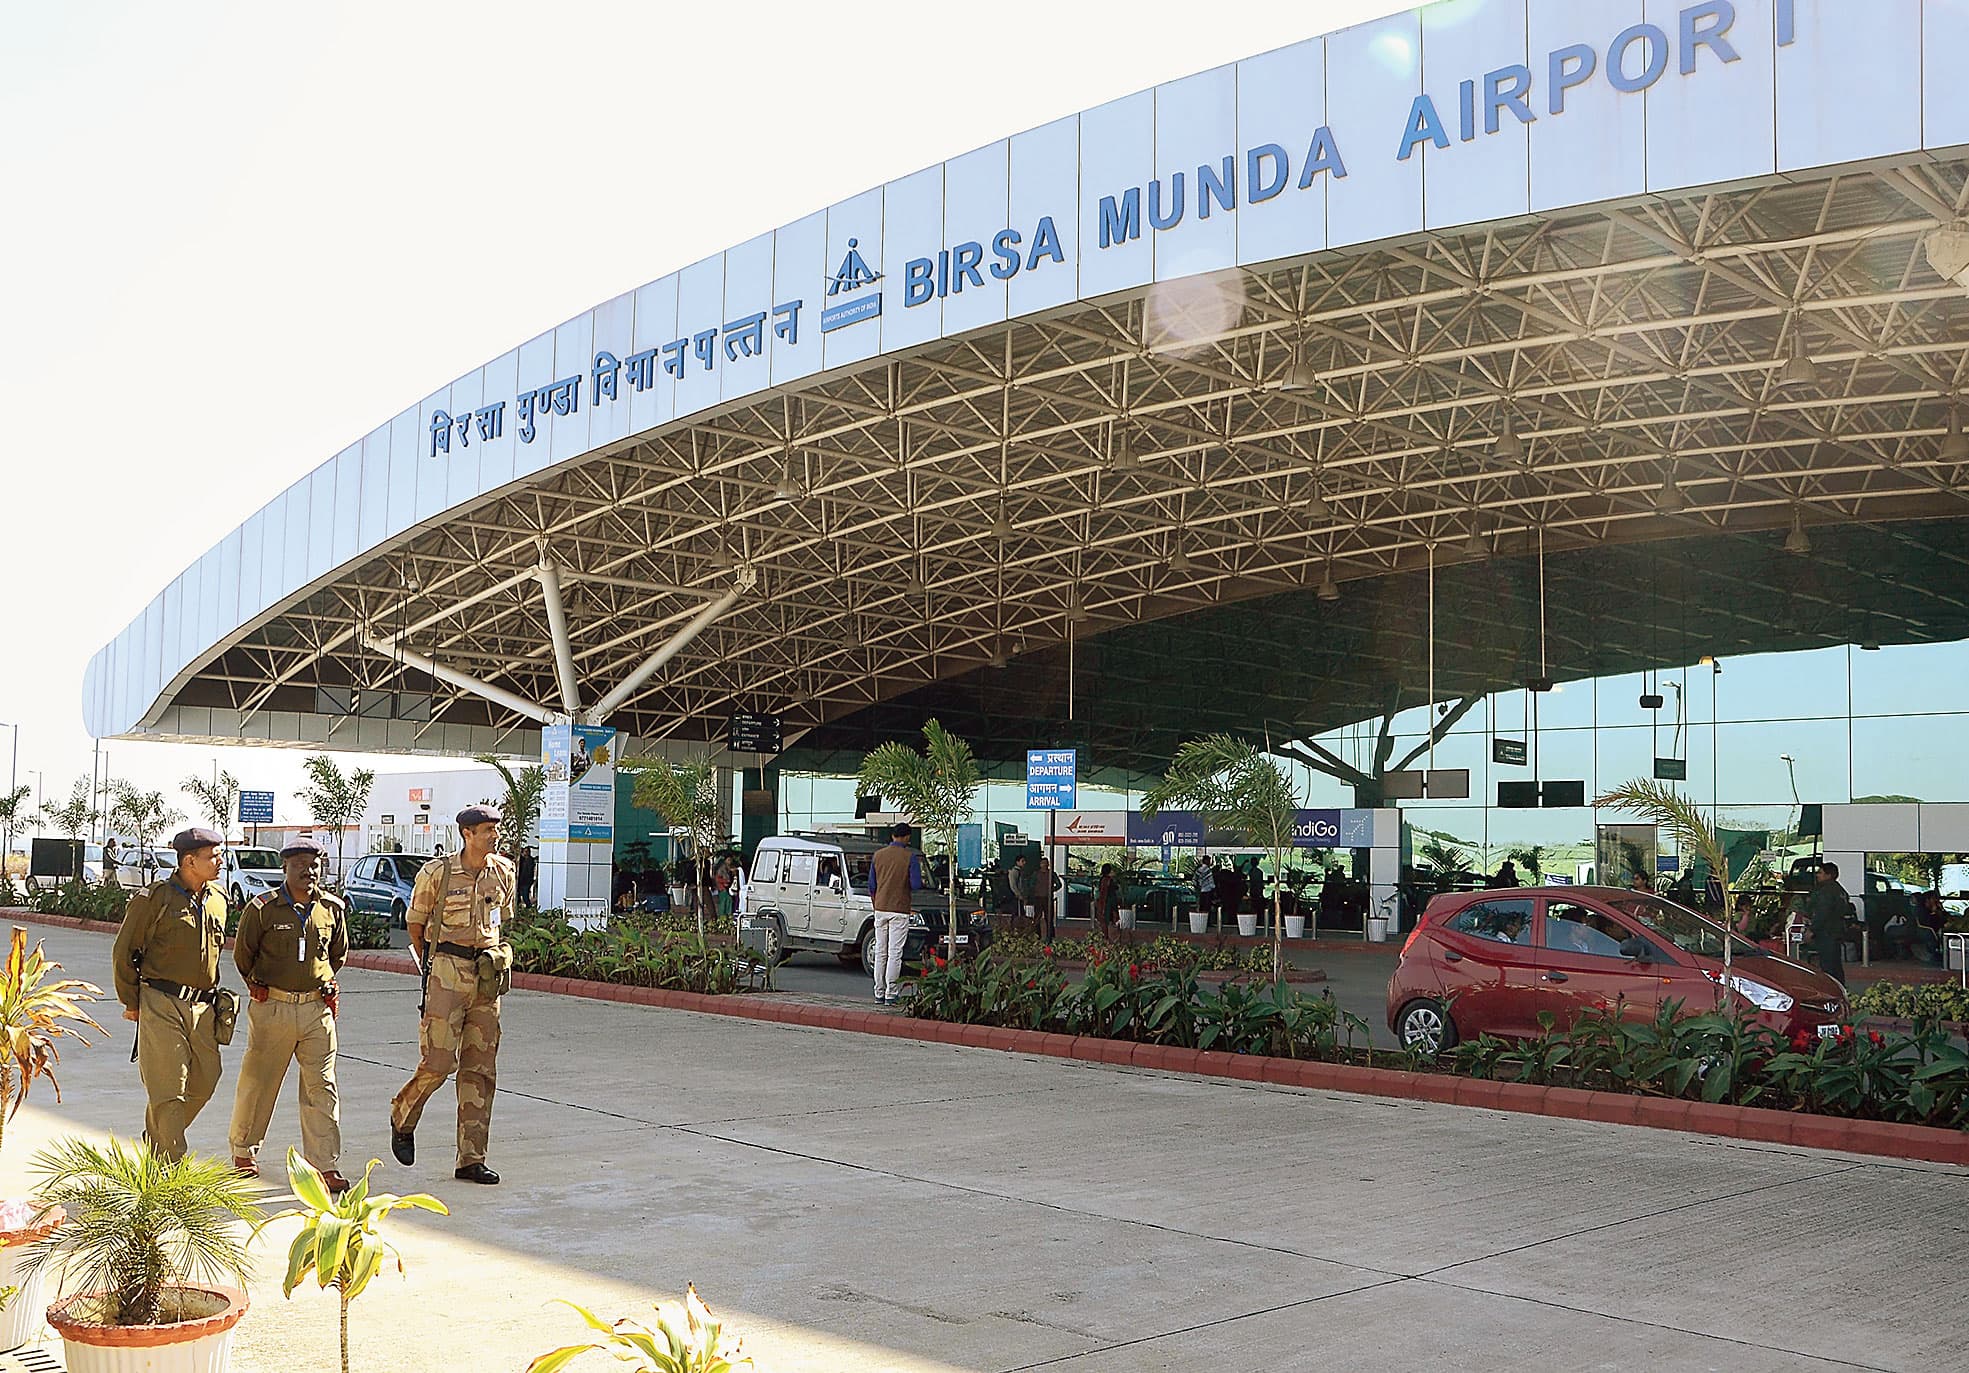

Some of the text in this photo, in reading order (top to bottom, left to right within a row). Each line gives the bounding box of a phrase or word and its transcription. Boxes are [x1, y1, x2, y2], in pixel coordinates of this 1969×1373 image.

[904, 216, 1064, 308] BIRSA
[1099, 126, 1348, 249] MUNDA
[430, 401, 506, 458] बिरसा
[517, 374, 582, 444] मुण्डा
[1047, 753, 1074, 764] प्रस्थान
[1029, 765, 1073, 776] DEPARTURE
[1028, 783, 1058, 794] आगमन
[1028, 796, 1061, 807] ARRIVAL
